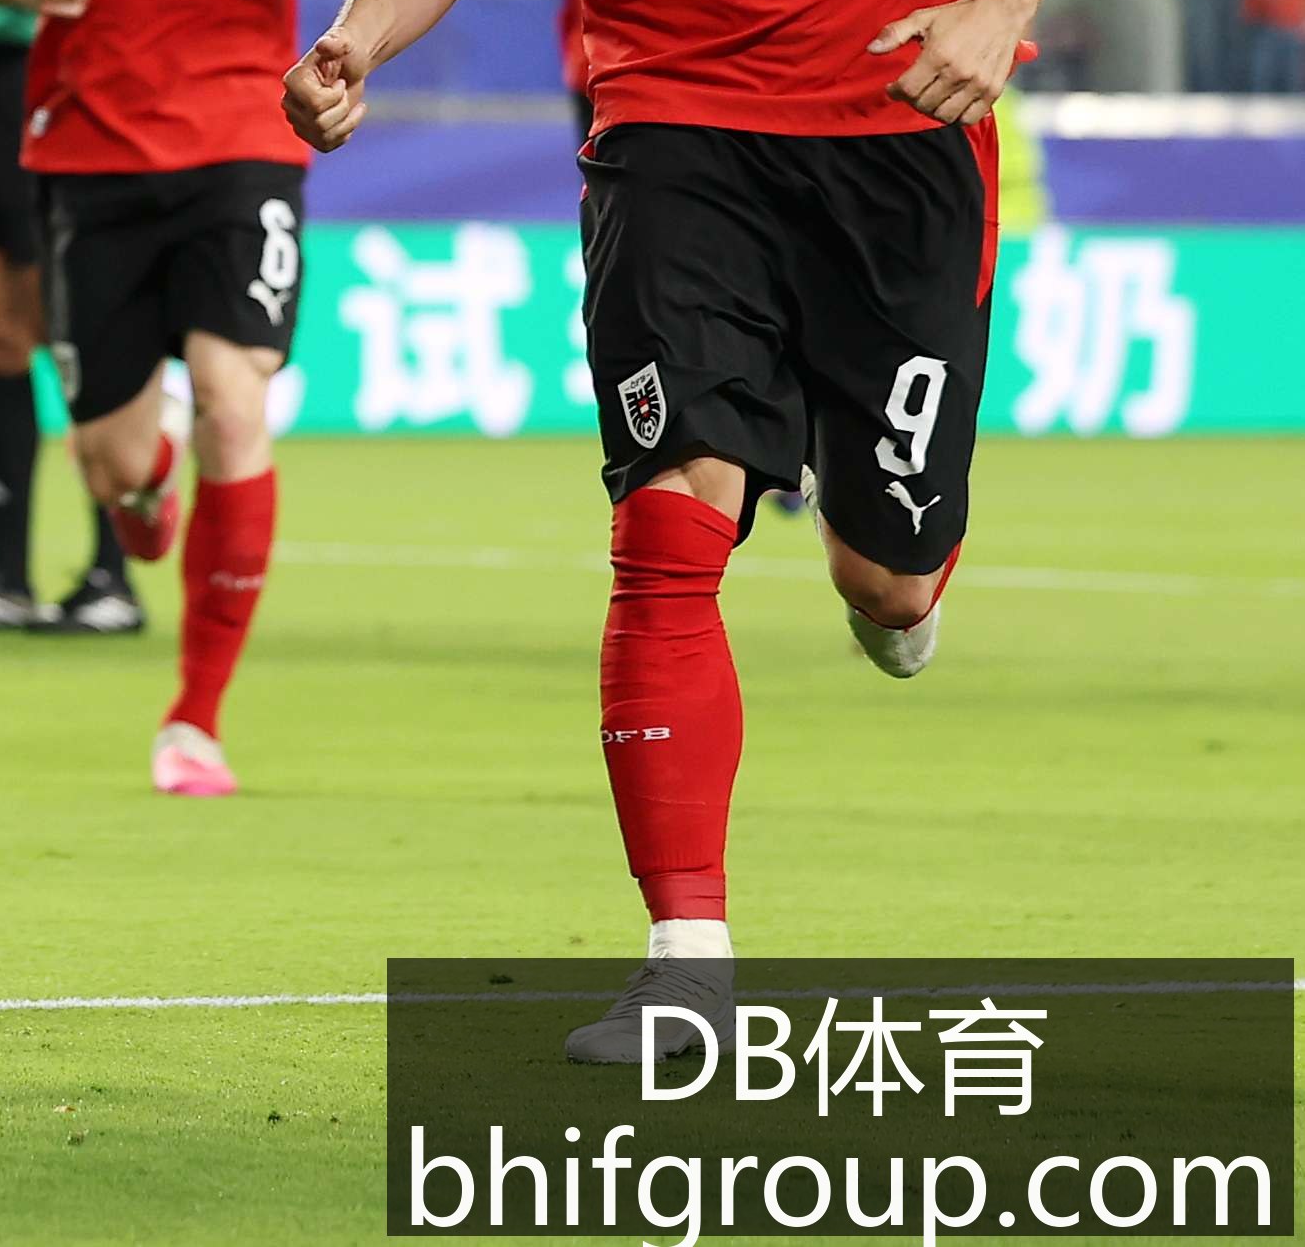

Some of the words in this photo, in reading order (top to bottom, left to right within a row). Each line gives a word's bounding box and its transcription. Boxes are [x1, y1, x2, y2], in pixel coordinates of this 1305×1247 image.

[259, 198, 300, 291] 6
[338, 221, 535, 438] 试
[1011, 223, 1197, 437] 奶
[874, 355, 948, 478] 9
